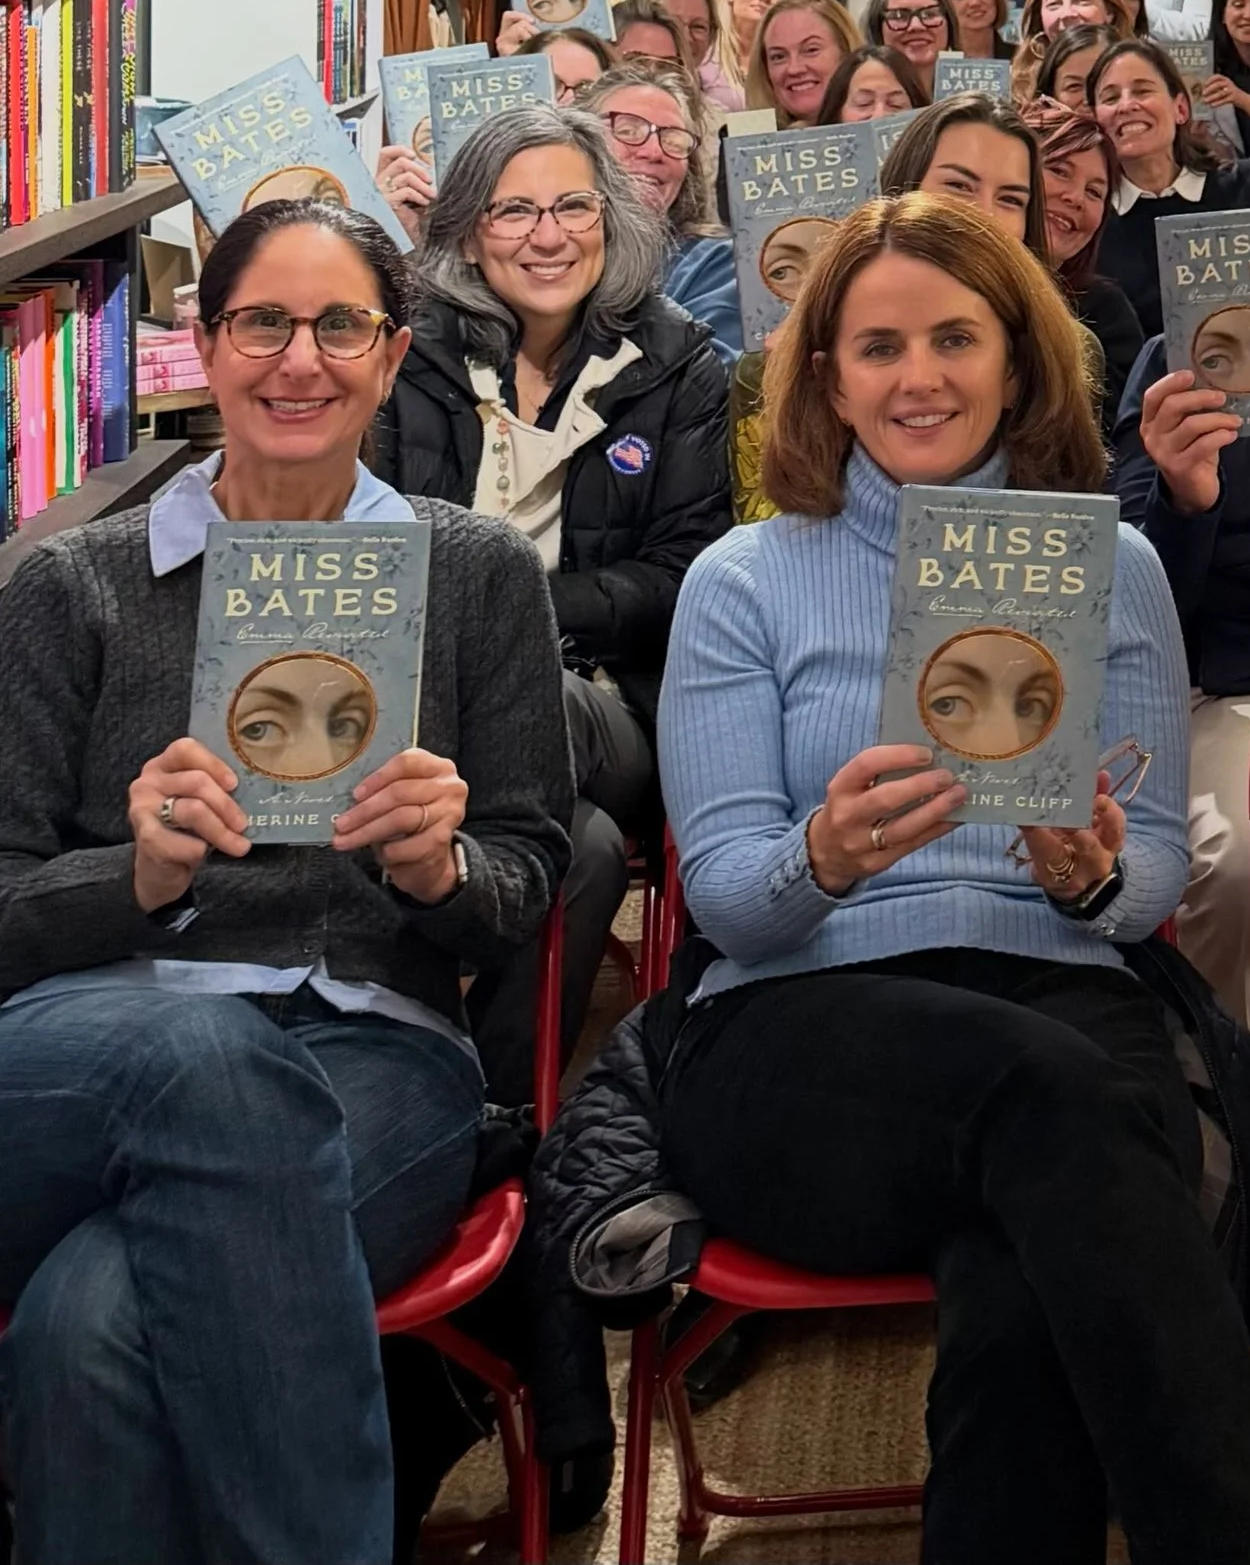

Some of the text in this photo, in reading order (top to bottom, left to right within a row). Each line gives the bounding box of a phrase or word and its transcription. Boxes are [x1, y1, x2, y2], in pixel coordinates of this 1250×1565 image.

[949, 67, 994, 80] MISS
[1173, 57, 1208, 66] ATES
[451, 74, 525, 98] MISS
[942, 79, 1001, 92] BATES
[440, 92, 537, 119] BATES
[192, 91, 286, 151] MISS
[190, 106, 313, 181] BATES
[754, 146, 842, 175] MISS
[742, 168, 859, 201] BATES
[943, 523, 1068, 557] MISS
[250, 553, 380, 582] MISS
[917, 558, 1086, 595] BATES
[225, 588, 398, 617] BATES
[929, 595, 984, 614] Emma
[236, 622, 294, 640] Emma
[1016, 795, 1073, 810] CLIFF
